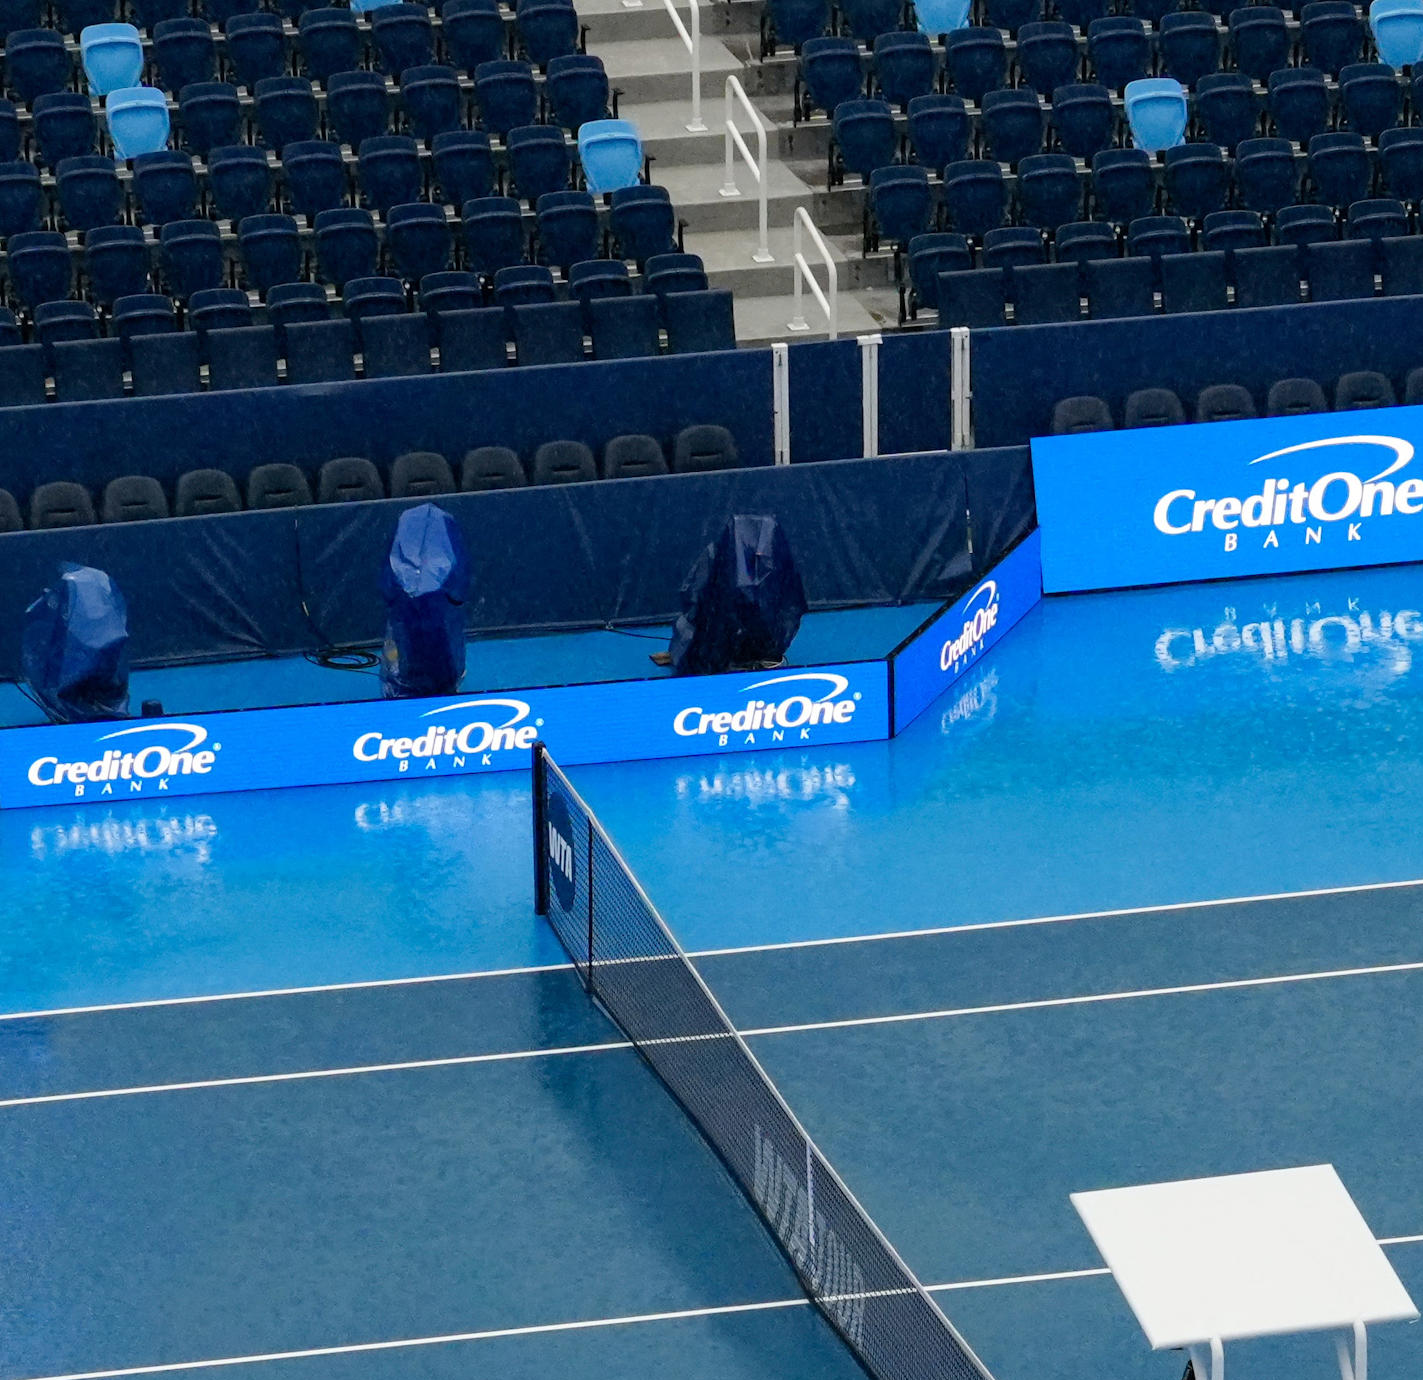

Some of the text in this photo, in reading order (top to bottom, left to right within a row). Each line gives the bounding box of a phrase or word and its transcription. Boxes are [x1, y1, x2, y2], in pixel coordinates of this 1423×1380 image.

[1224, 522, 1363, 553] BANK
[941, 603, 998, 671] CreditOne
[673, 695, 856, 737] CreditOne
[352, 721, 538, 762] CreditOne
[719, 727, 812, 747] BANK
[28, 745, 216, 786] CreditOne
[398, 752, 493, 772] BANK
[75, 777, 169, 798] BANK
[548, 821, 573, 882] WTA
